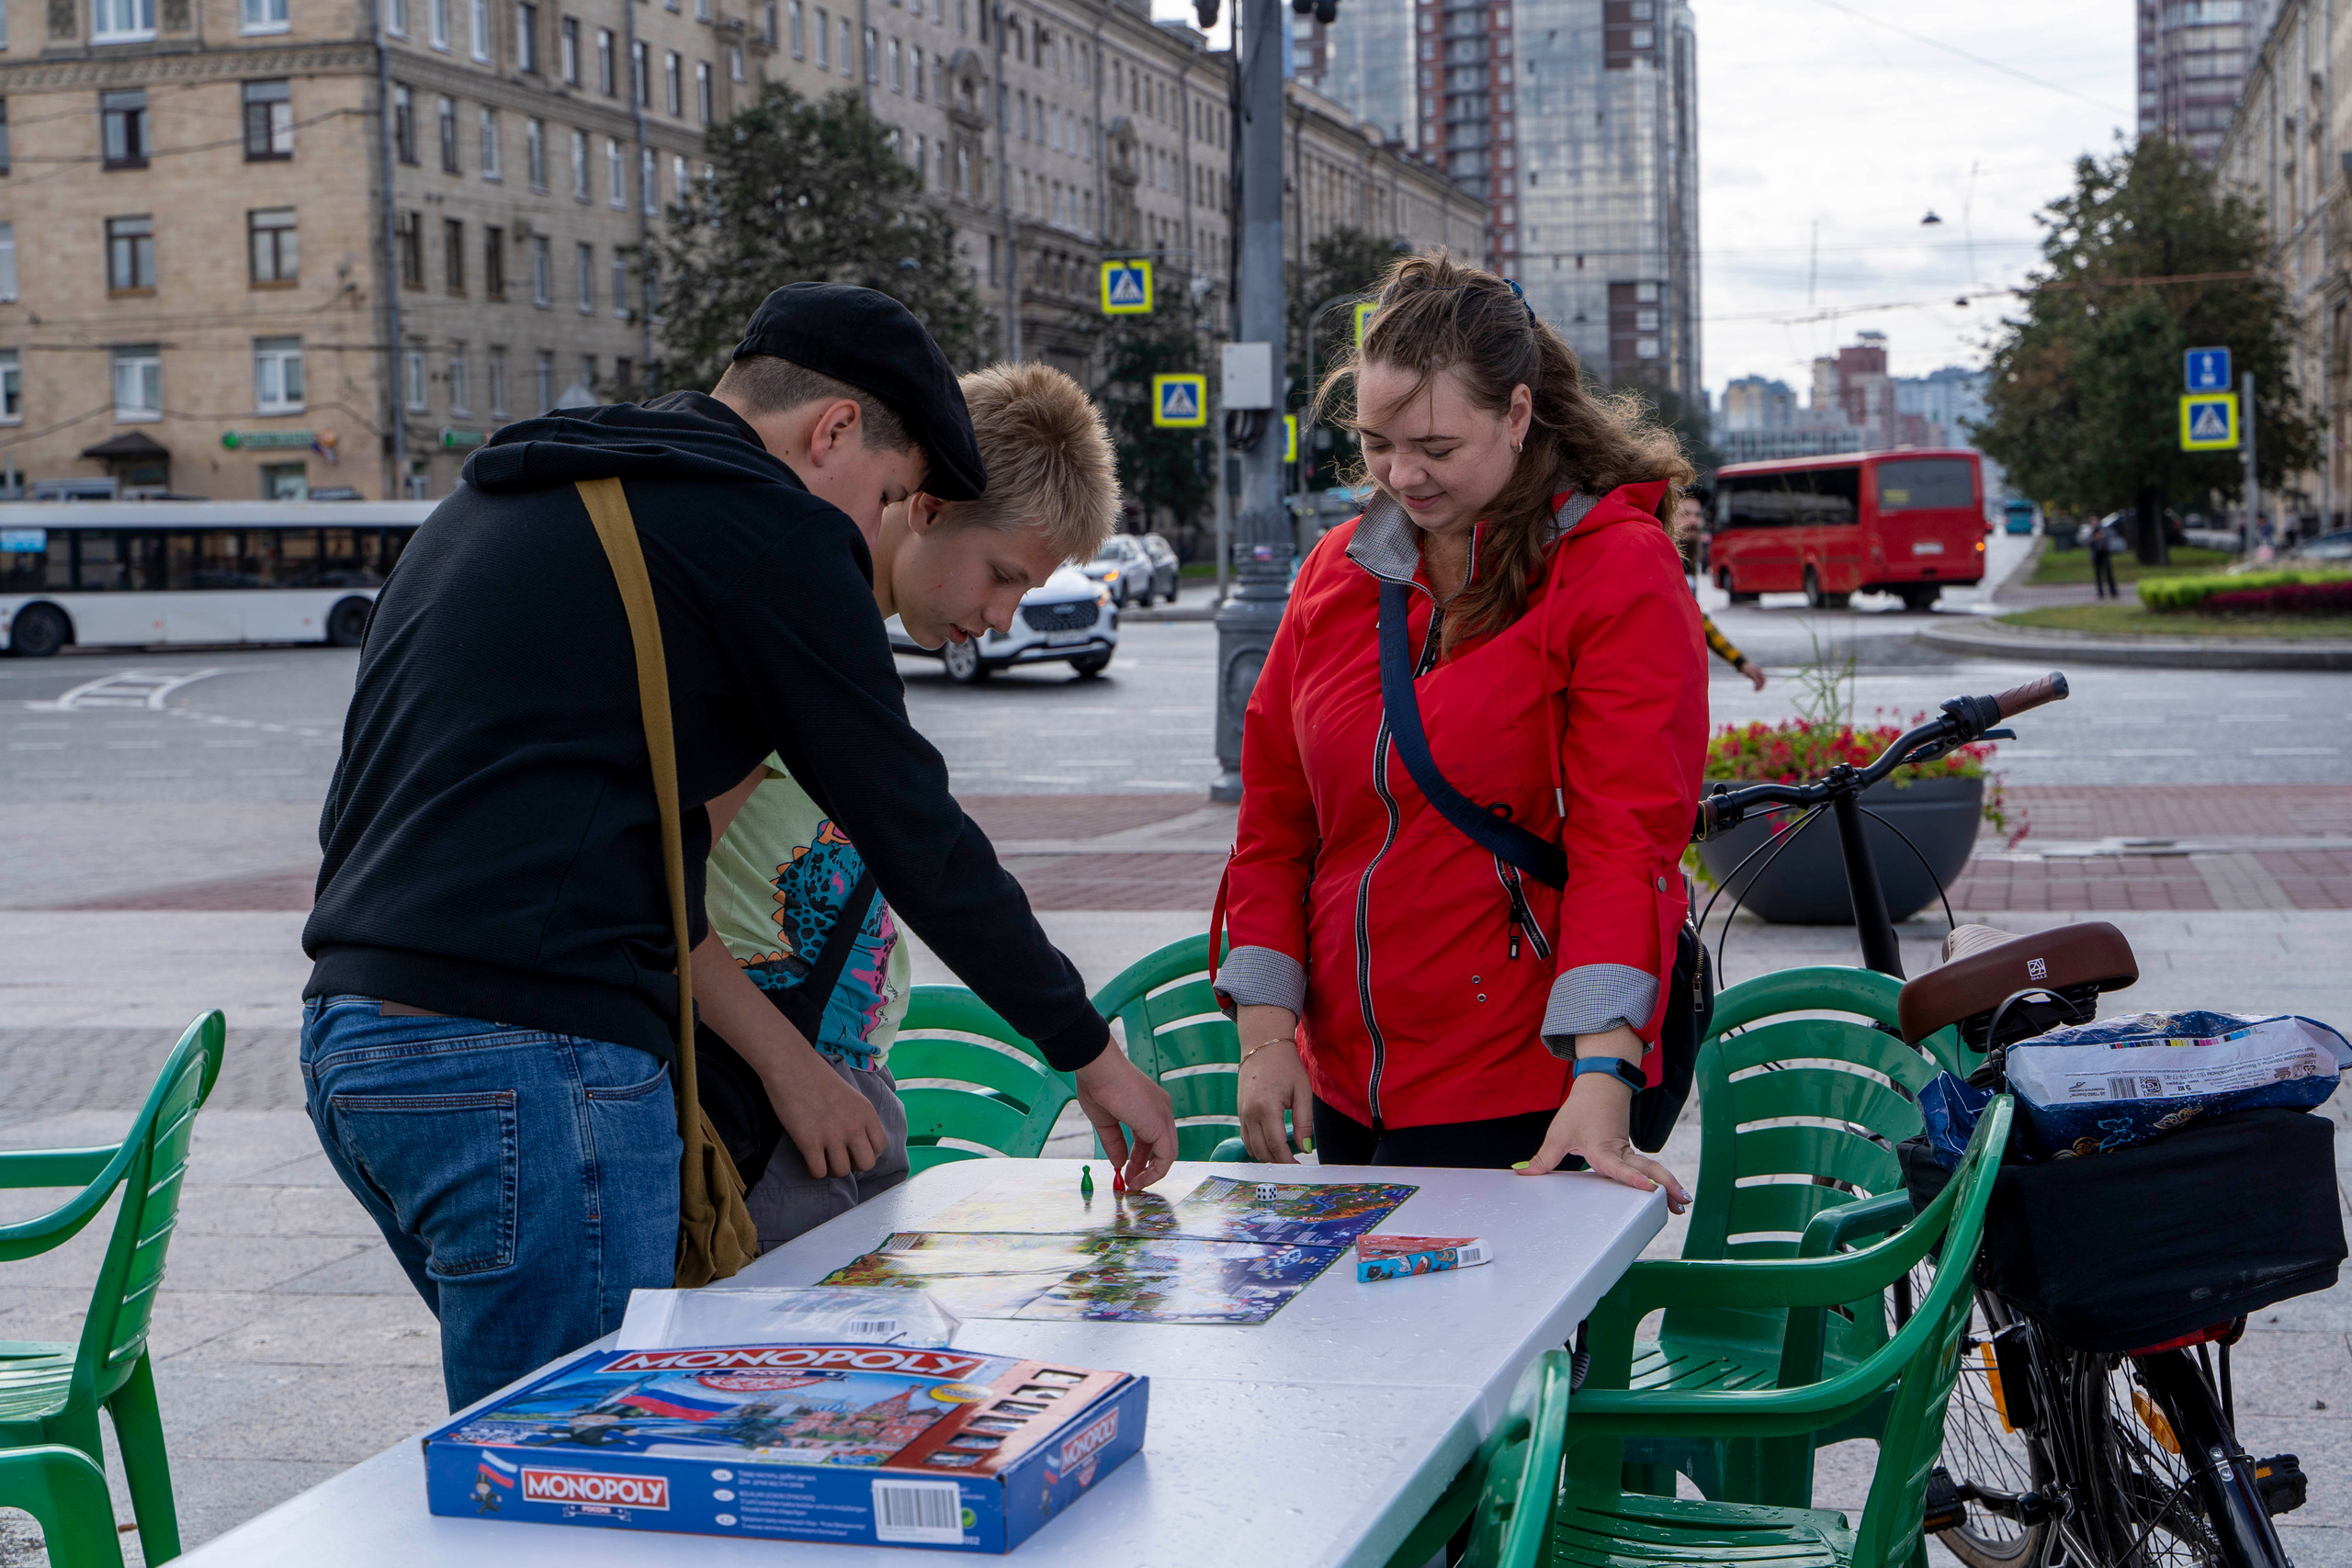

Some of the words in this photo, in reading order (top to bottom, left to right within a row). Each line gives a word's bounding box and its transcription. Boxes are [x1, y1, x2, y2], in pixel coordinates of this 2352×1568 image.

[616, 1349, 974, 1375] MONOPOLY
[1064, 1416, 1115, 1472] MONOPOLY
[527, 1473, 662, 1505] MONOPOLY
